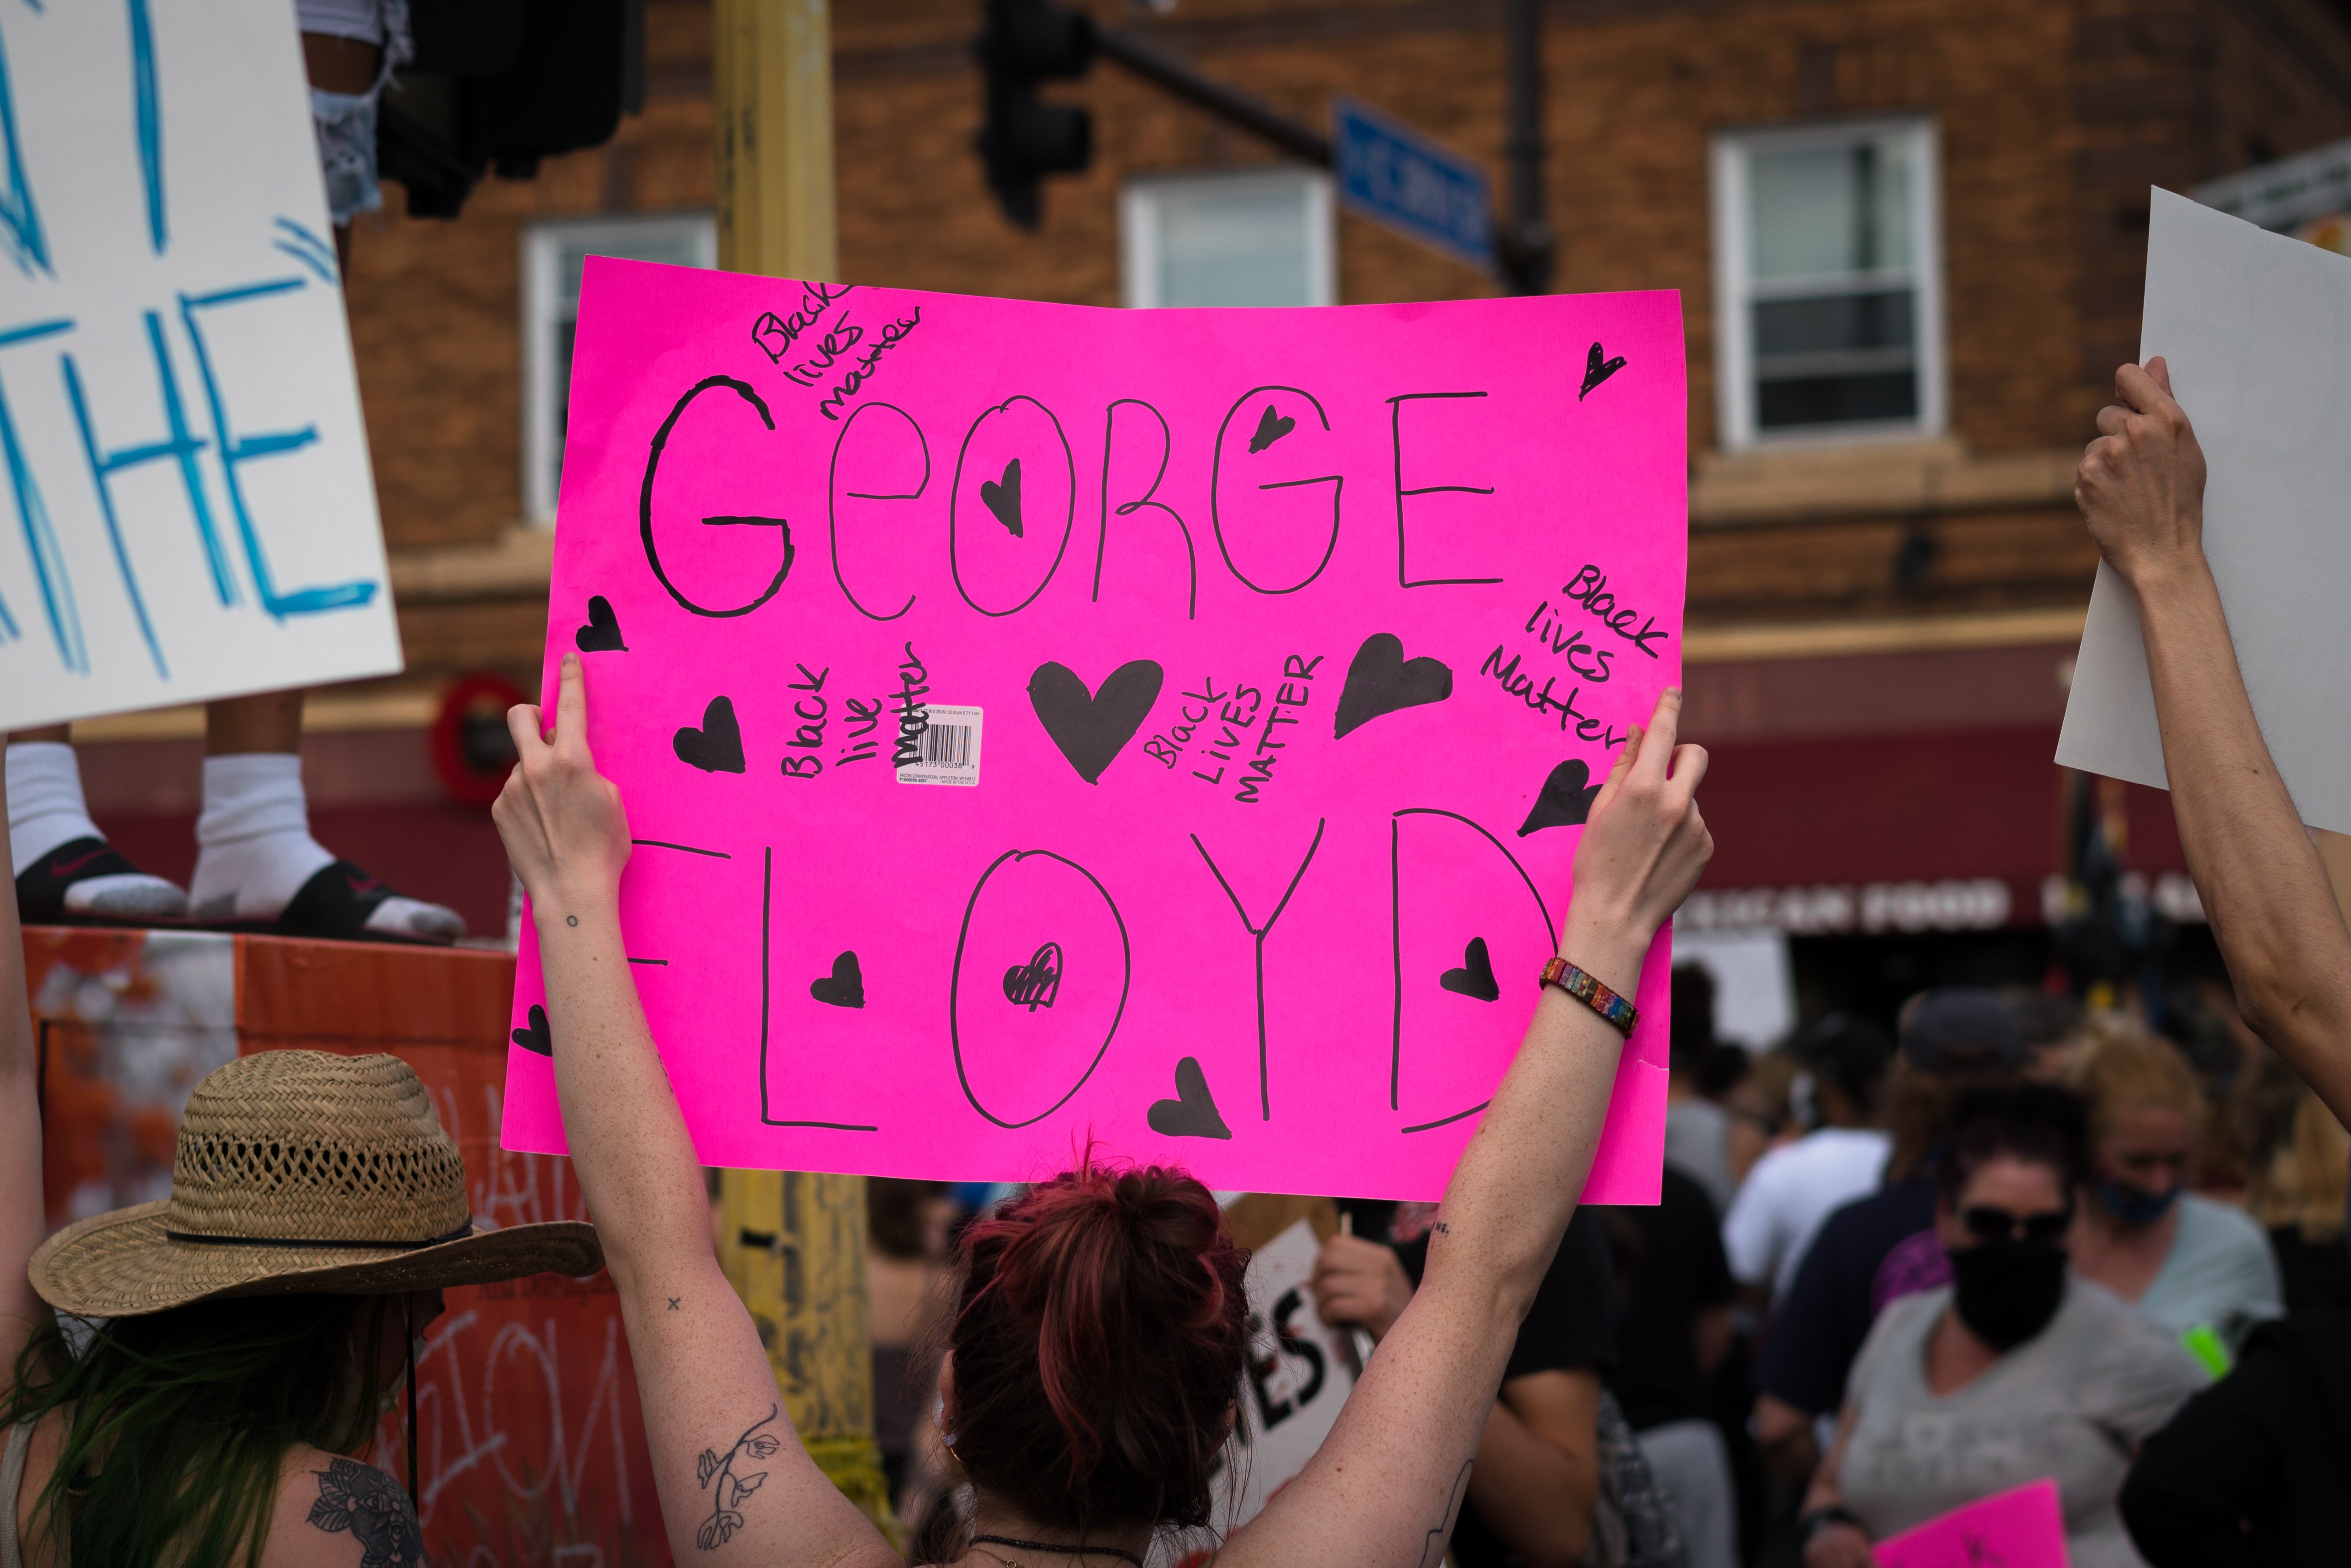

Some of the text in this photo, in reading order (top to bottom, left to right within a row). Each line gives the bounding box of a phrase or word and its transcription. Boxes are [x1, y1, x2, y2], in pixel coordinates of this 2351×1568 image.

[783, 310, 864, 387] lives
[1234, 654, 1324, 803] MATTER
[1480, 644, 1627, 751] Matter
[1861, 879, 2012, 933] FOOD
